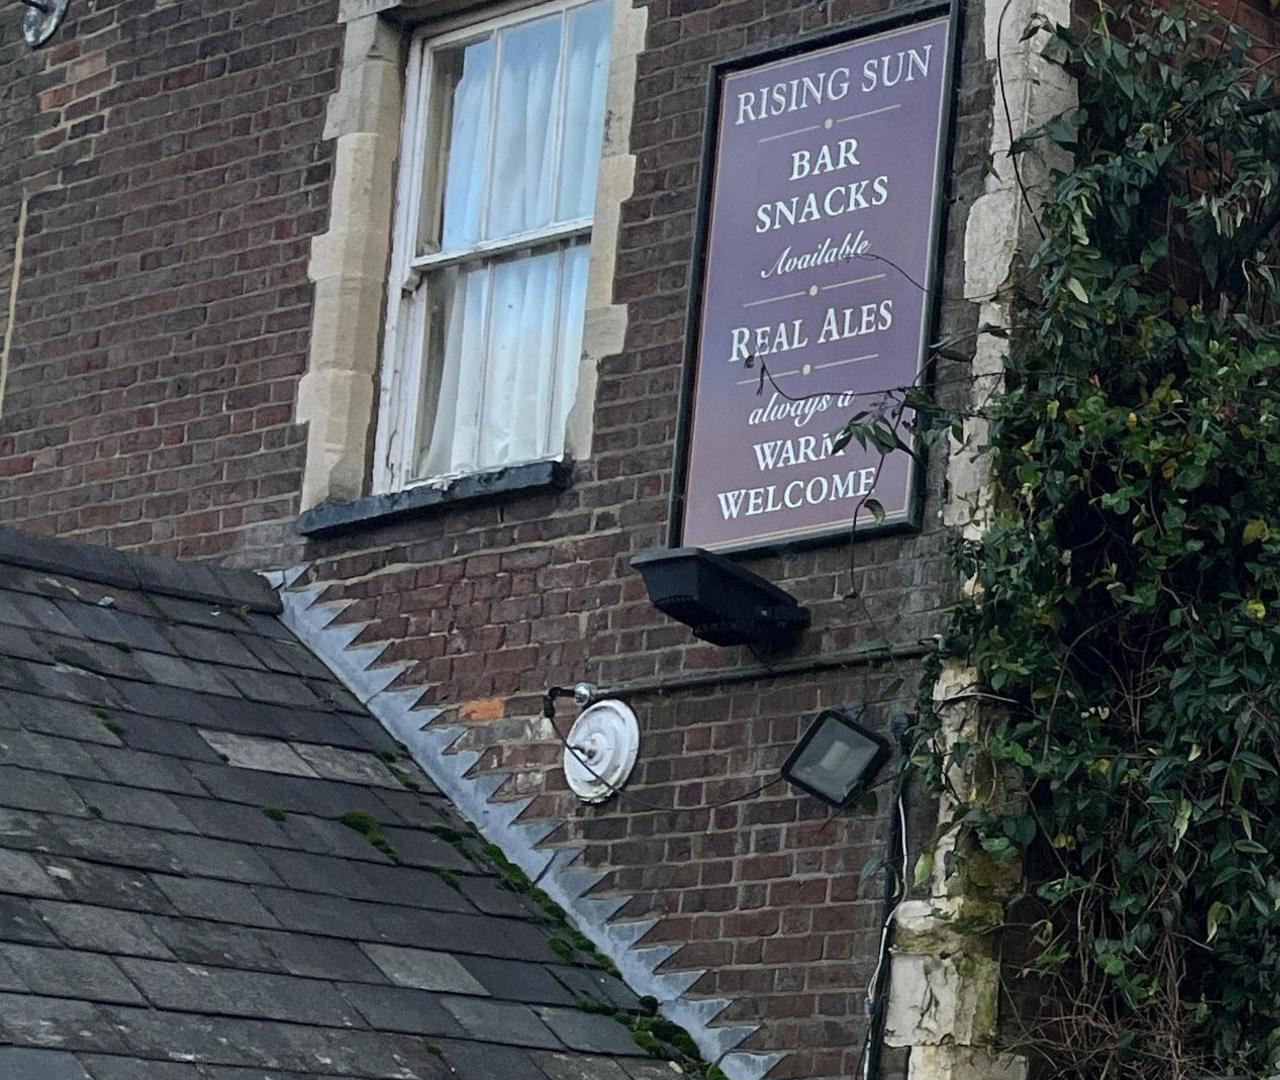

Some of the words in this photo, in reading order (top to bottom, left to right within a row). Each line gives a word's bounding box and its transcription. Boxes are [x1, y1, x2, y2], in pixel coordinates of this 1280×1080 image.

[735, 68, 851, 126] RISING
[861, 45, 933, 92] SUN
[788, 139, 861, 181] BAR
[755, 176, 889, 233] SNACKS
[760, 230, 871, 279] Available
[728, 319, 809, 362] REAL
[817, 300, 894, 343] ALES
[748, 391, 830, 427] always
[837, 389, 855, 408] a
[752, 433, 847, 471] WARM
[717, 467, 877, 520] WELCOME
